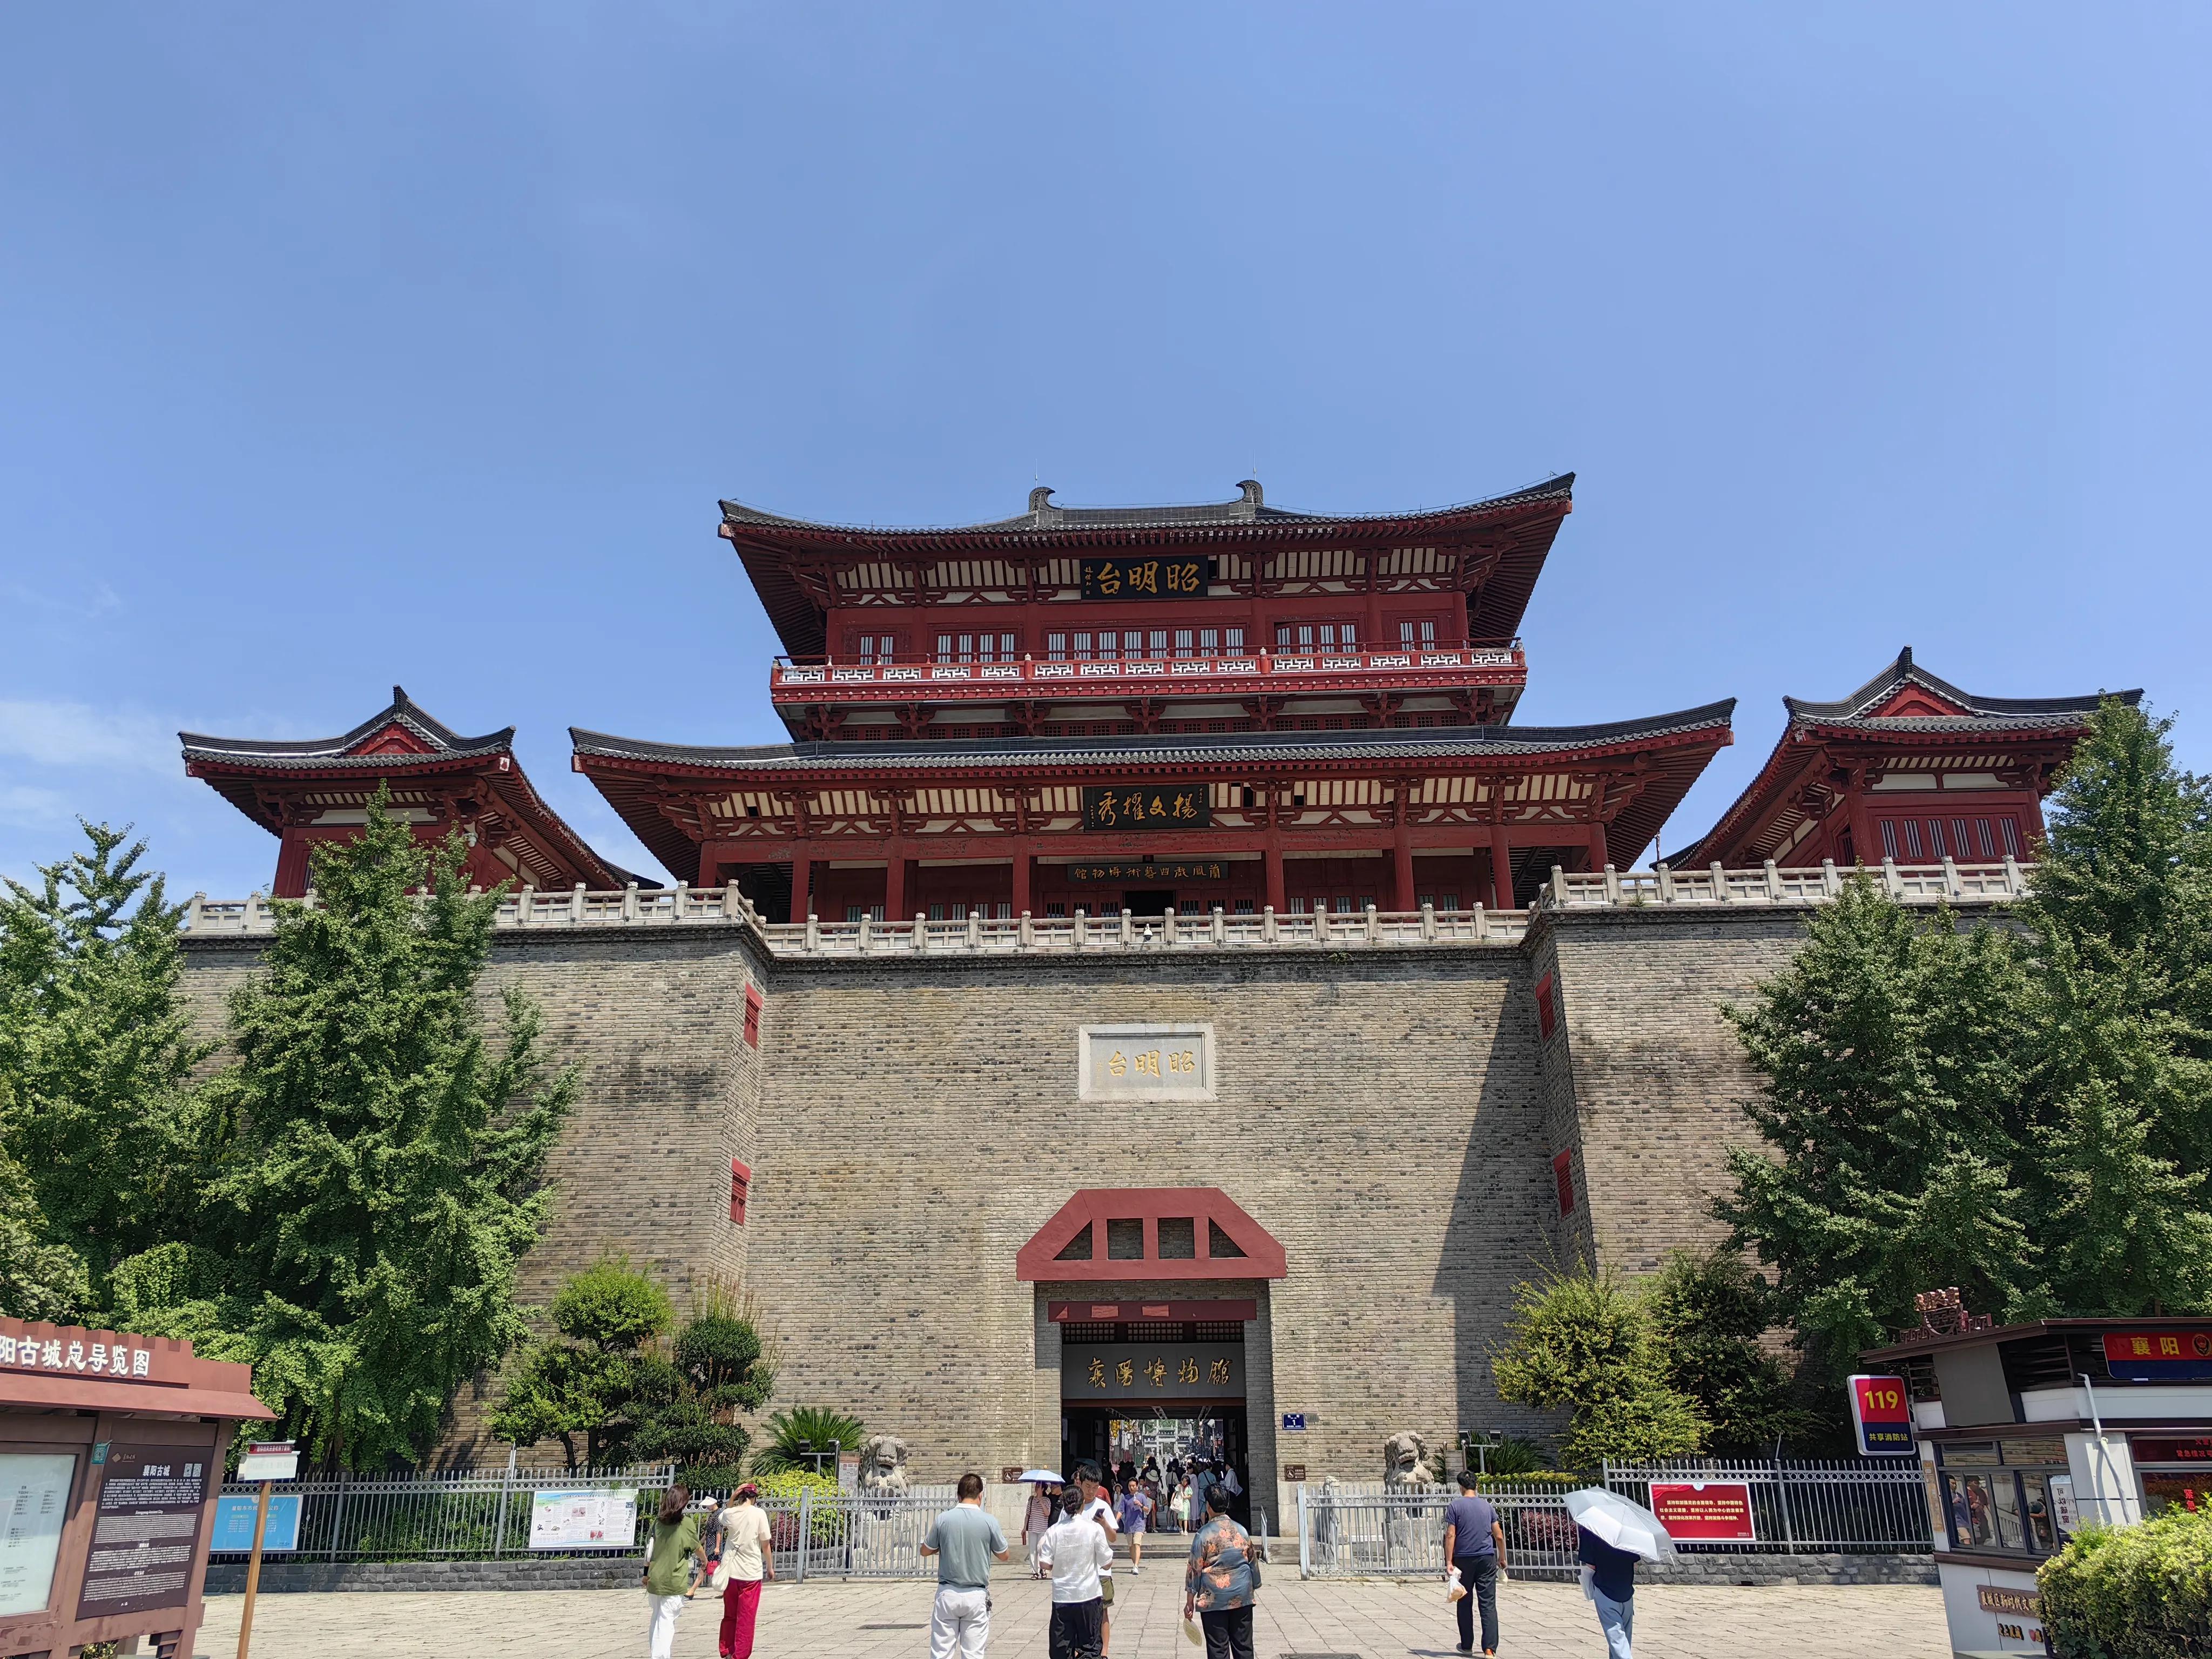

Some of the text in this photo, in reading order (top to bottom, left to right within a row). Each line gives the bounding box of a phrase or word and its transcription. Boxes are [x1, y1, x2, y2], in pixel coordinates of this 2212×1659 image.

[1865, 1391, 1898, 1408] 119
[1869, 1433, 1908, 1441] 共享消防站
[143, 1465, 170, 1476] 襄阳古城
